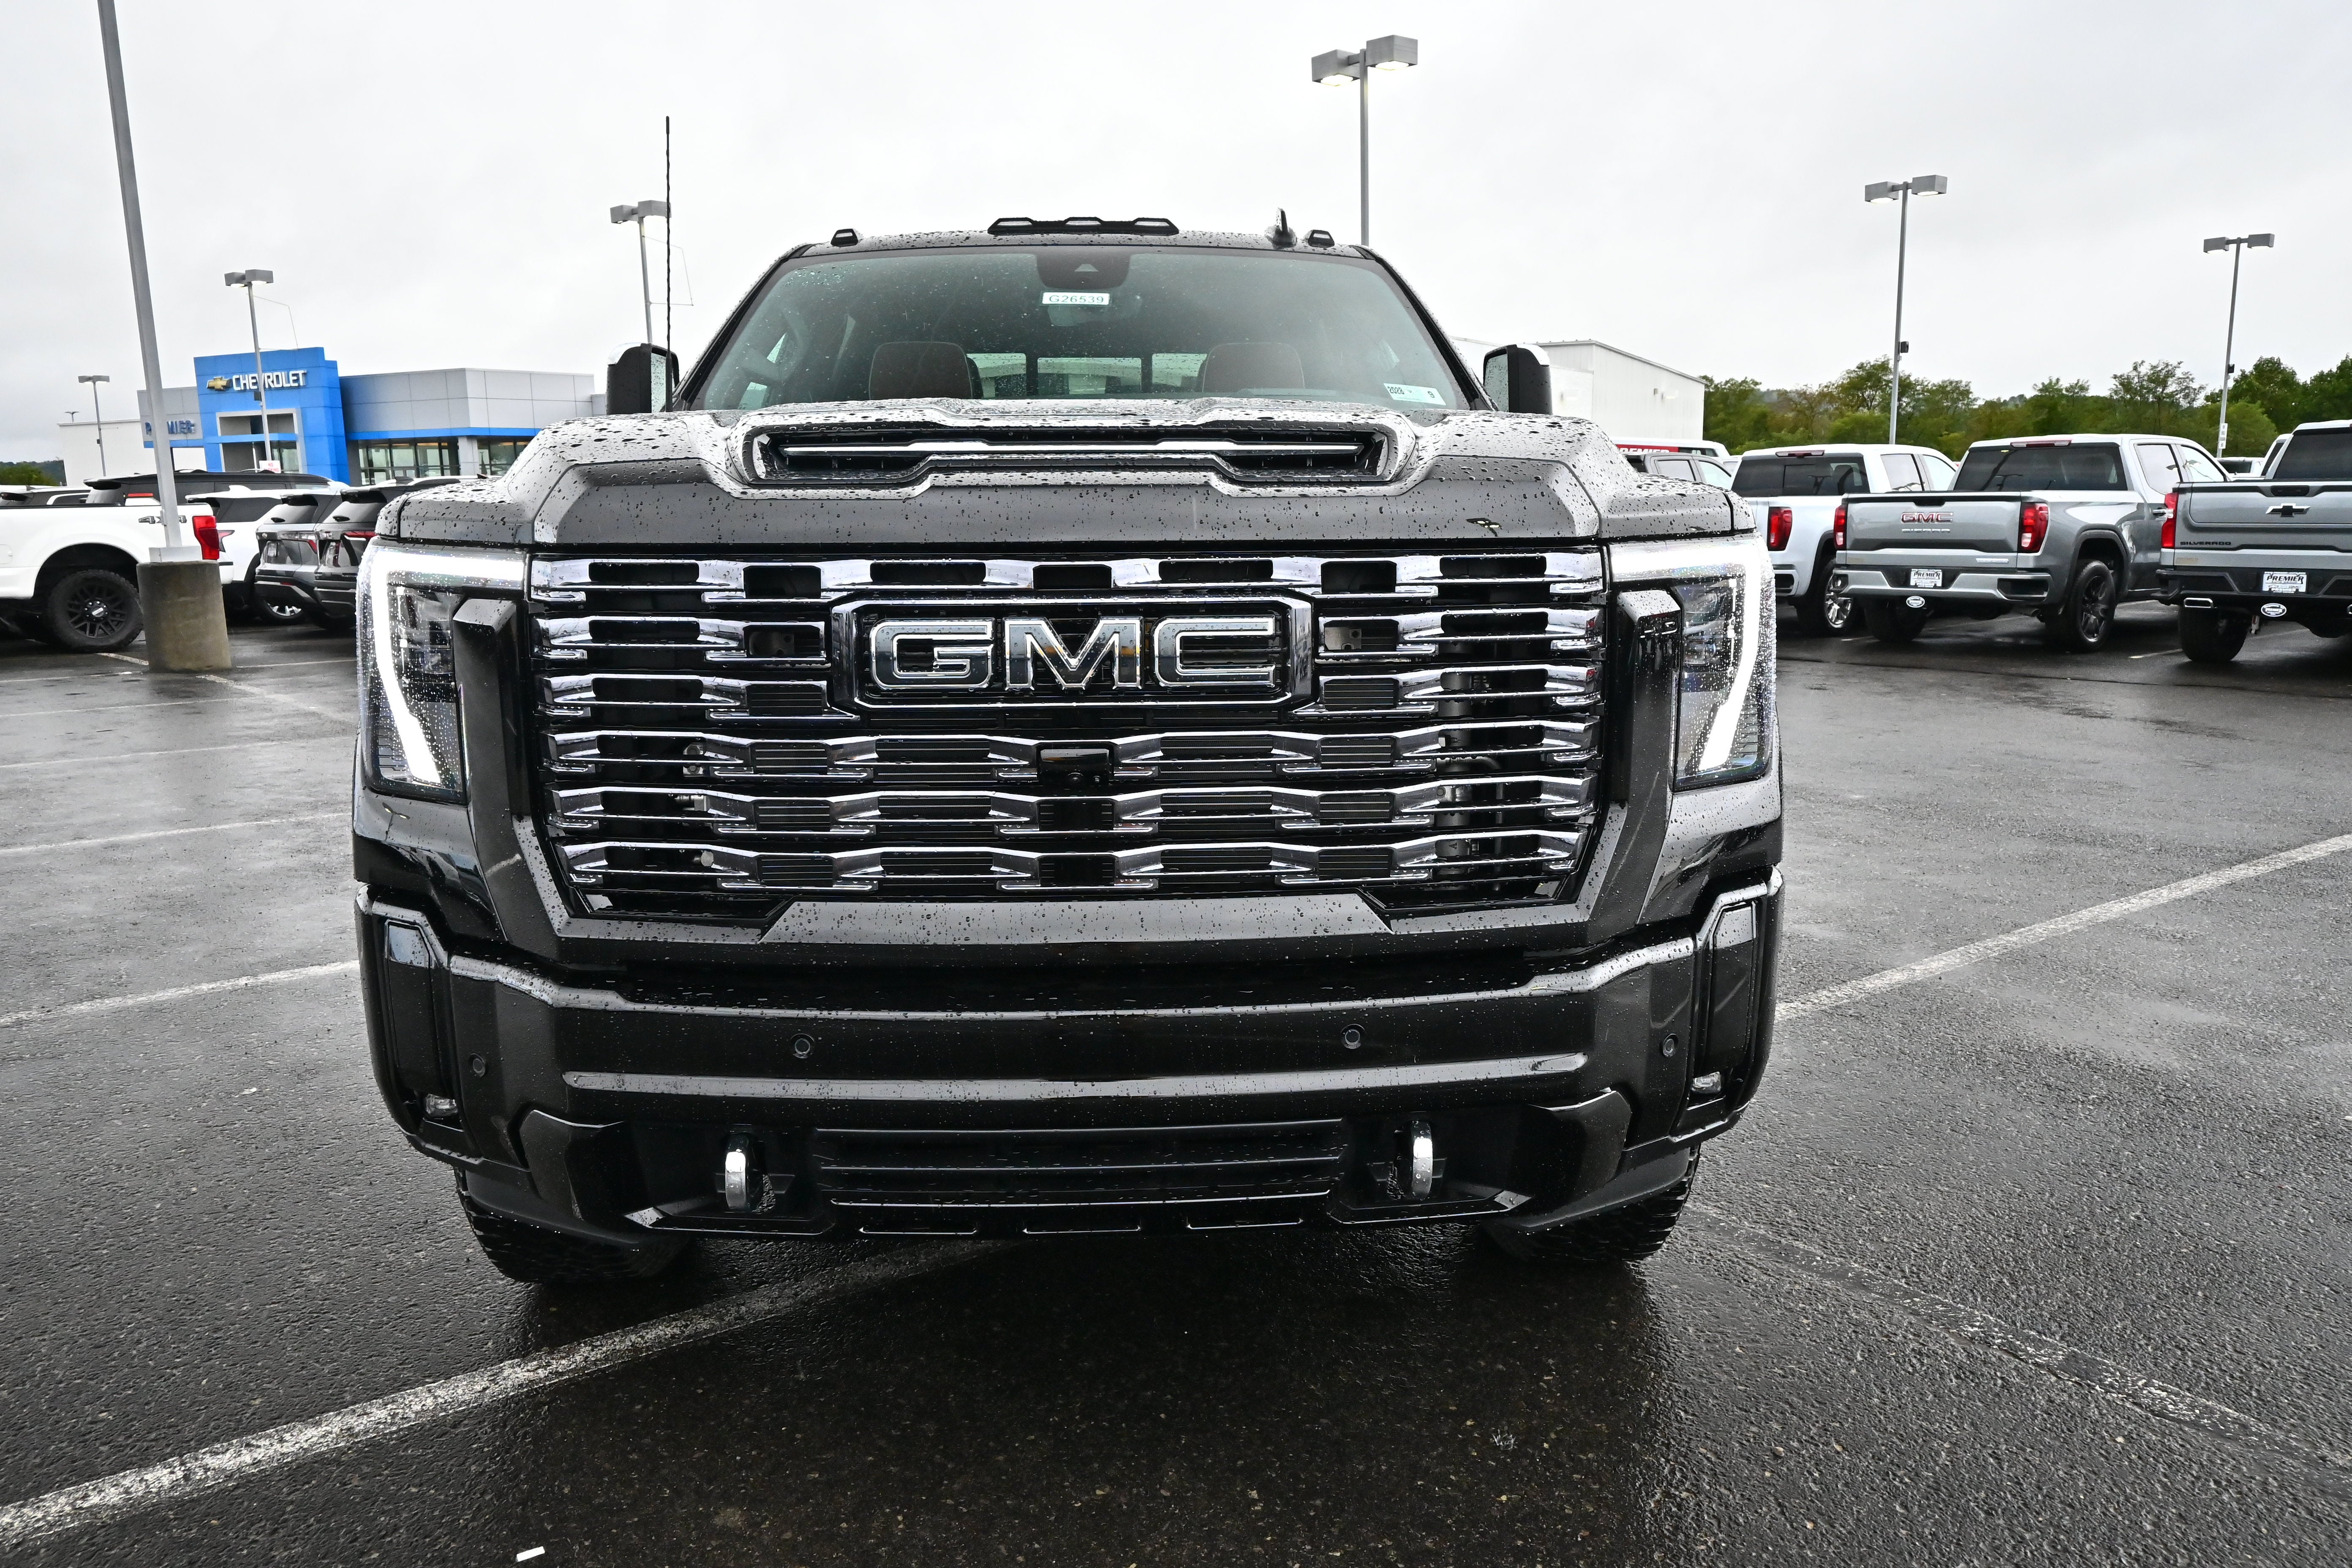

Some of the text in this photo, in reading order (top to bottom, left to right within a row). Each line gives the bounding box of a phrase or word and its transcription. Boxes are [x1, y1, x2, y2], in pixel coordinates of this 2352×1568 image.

[1049, 295, 1104, 303] G26539
[1388, 386, 1405, 395] 2028
[145, 420, 195, 436] PMIER
[1901, 512, 1953, 523] GMC
[2267, 575, 2304, 584] PREMIER
[870, 617, 1275, 691] GMC
